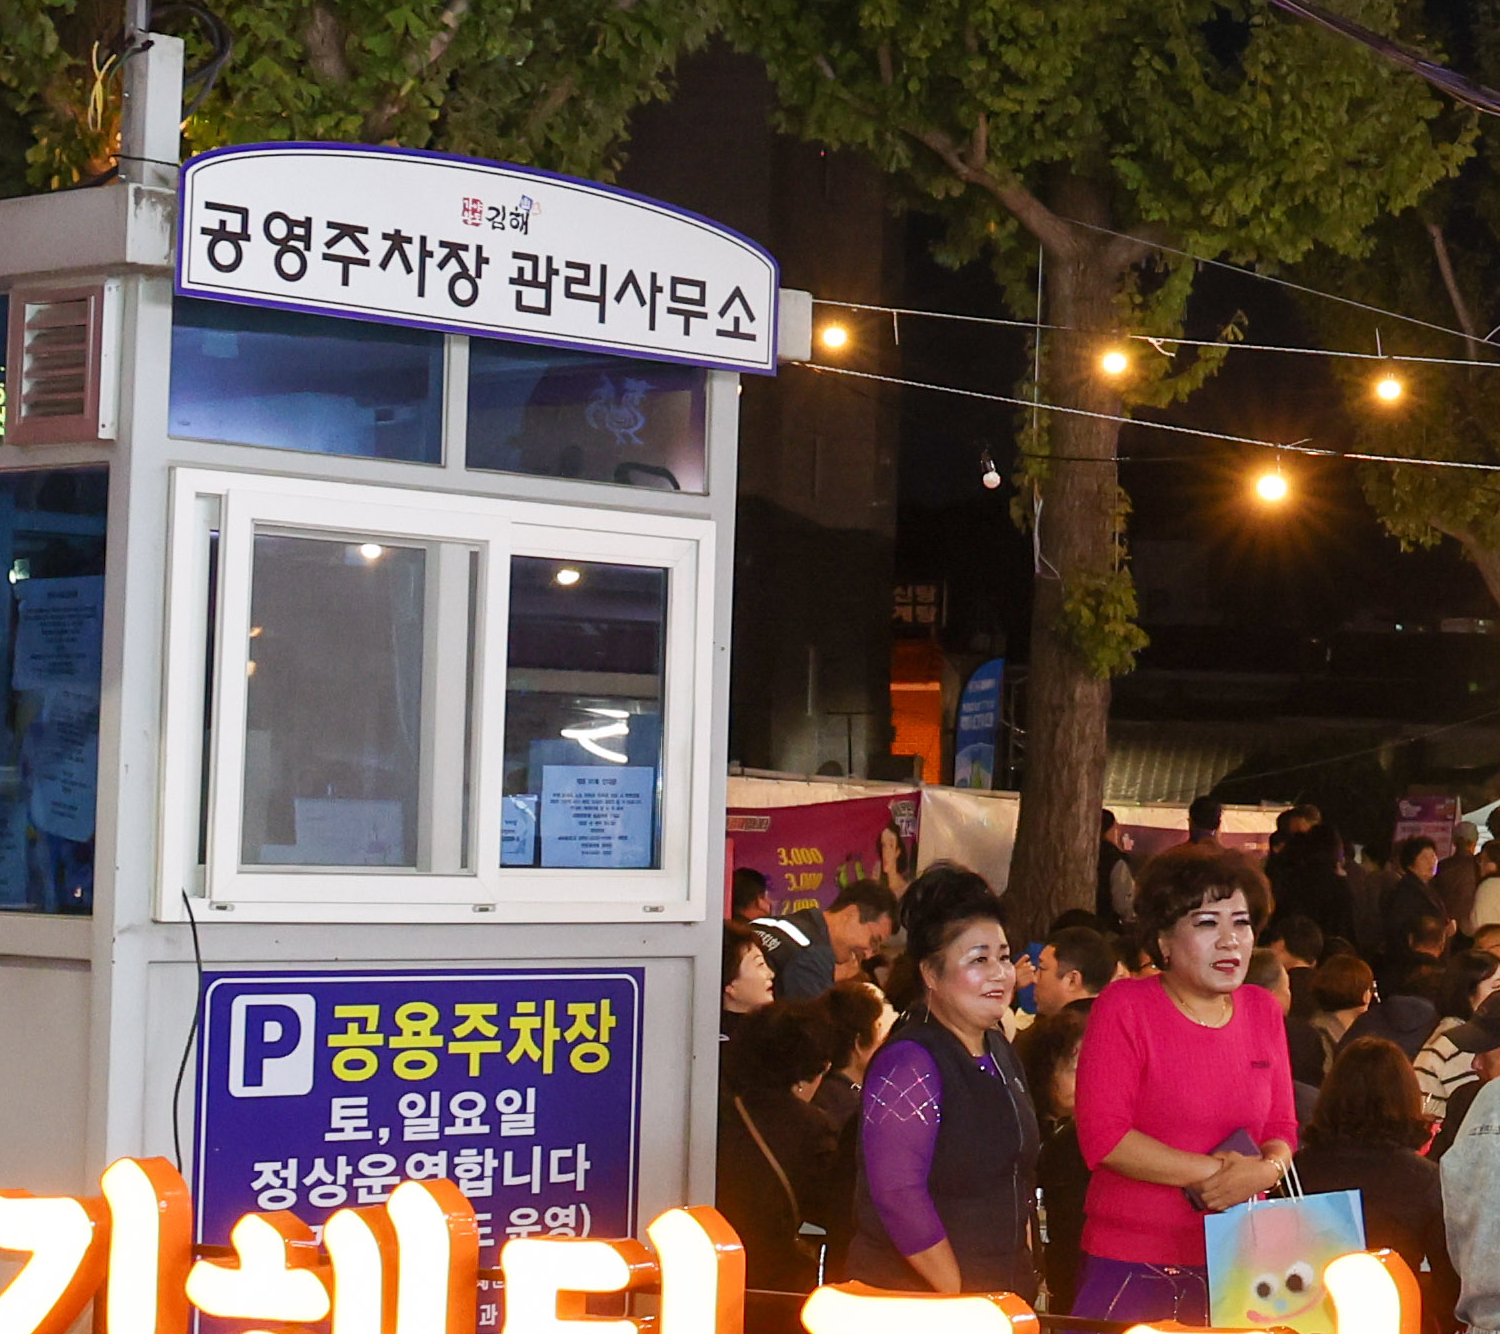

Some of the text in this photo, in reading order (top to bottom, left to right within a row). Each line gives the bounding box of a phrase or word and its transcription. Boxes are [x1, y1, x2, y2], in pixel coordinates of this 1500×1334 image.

[486, 205, 529, 235] 김해
[201, 200, 758, 344] 공영주차장 관리사무소
[241, 998, 617, 1088] P 공용주차장
[323, 1087, 538, 1144] 토,일요일
[250, 1144, 592, 1211] 정상운영합니다
